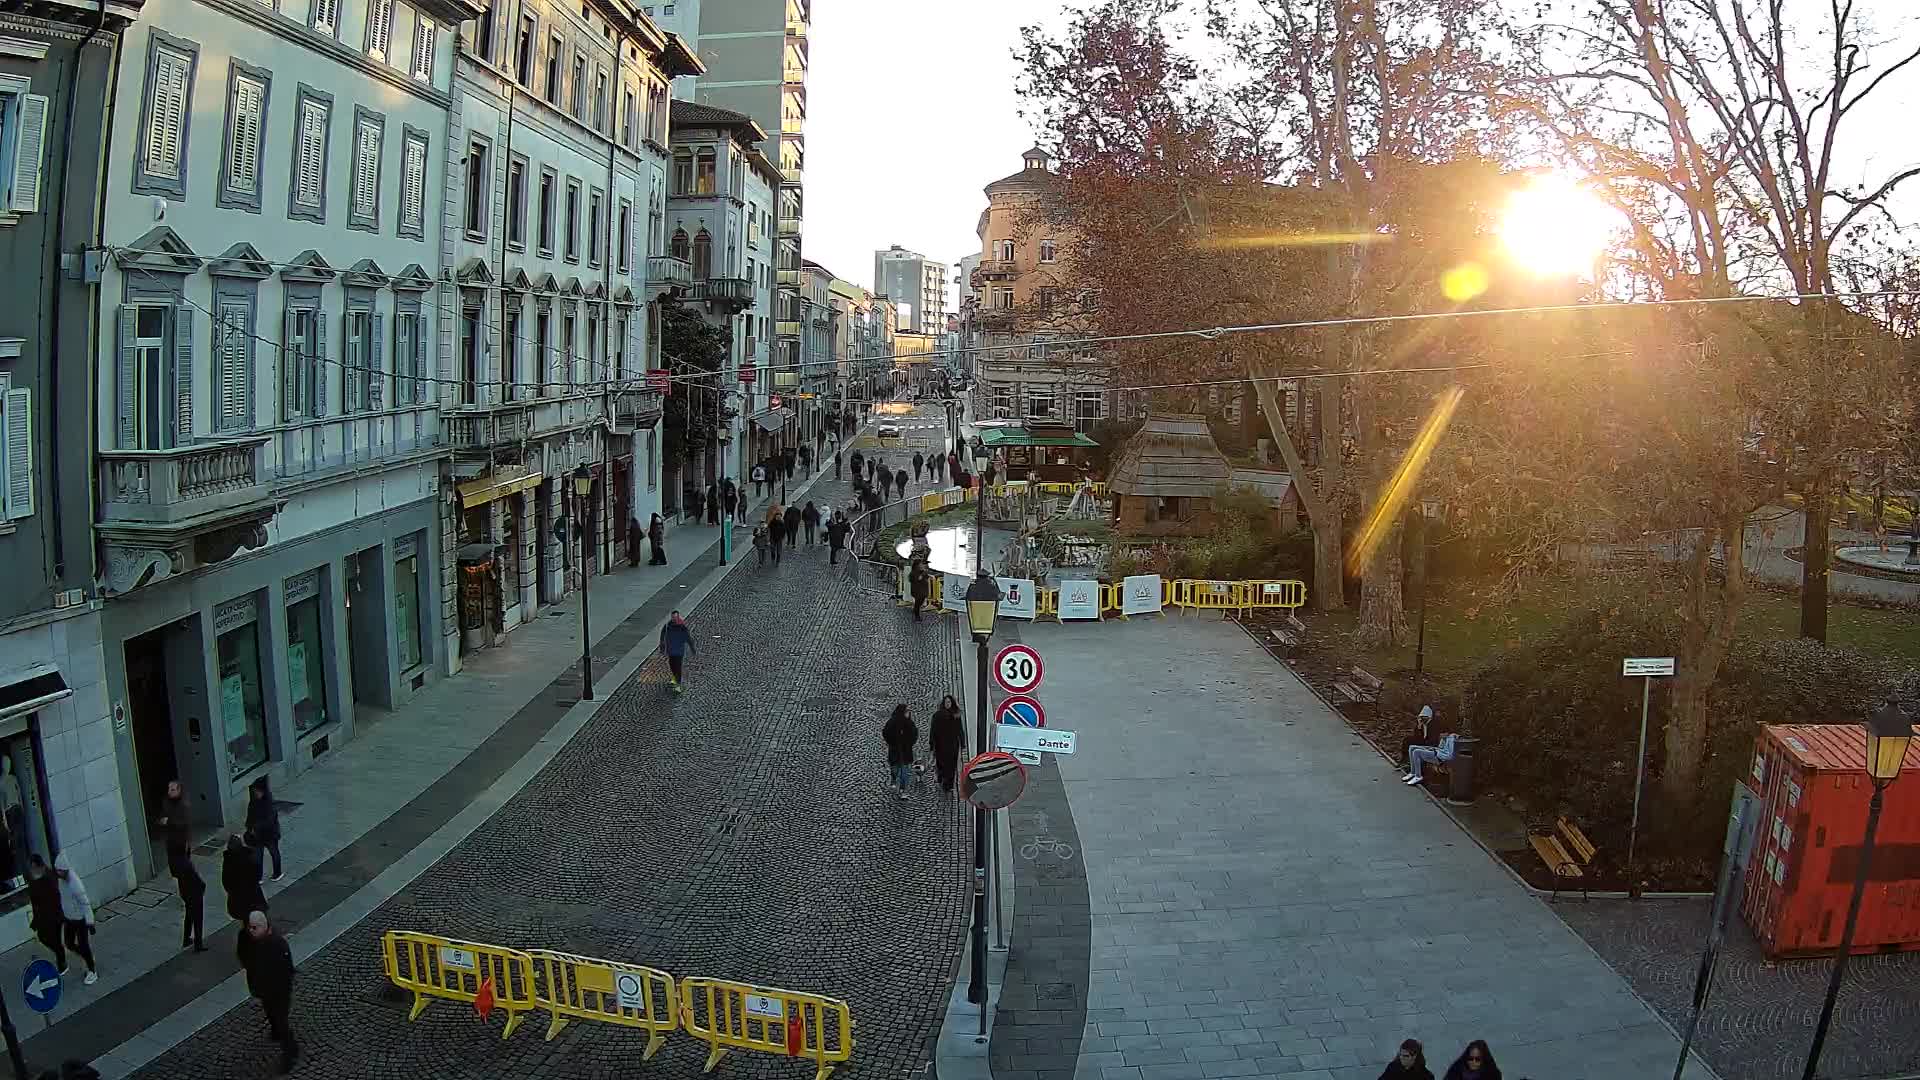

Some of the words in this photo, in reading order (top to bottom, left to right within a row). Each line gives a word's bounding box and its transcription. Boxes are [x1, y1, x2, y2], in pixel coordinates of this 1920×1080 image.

[216, 612, 244, 629] OPERATIVO
[1006, 658, 1033, 680] 30
[1038, 738, 1070, 749] Dante
